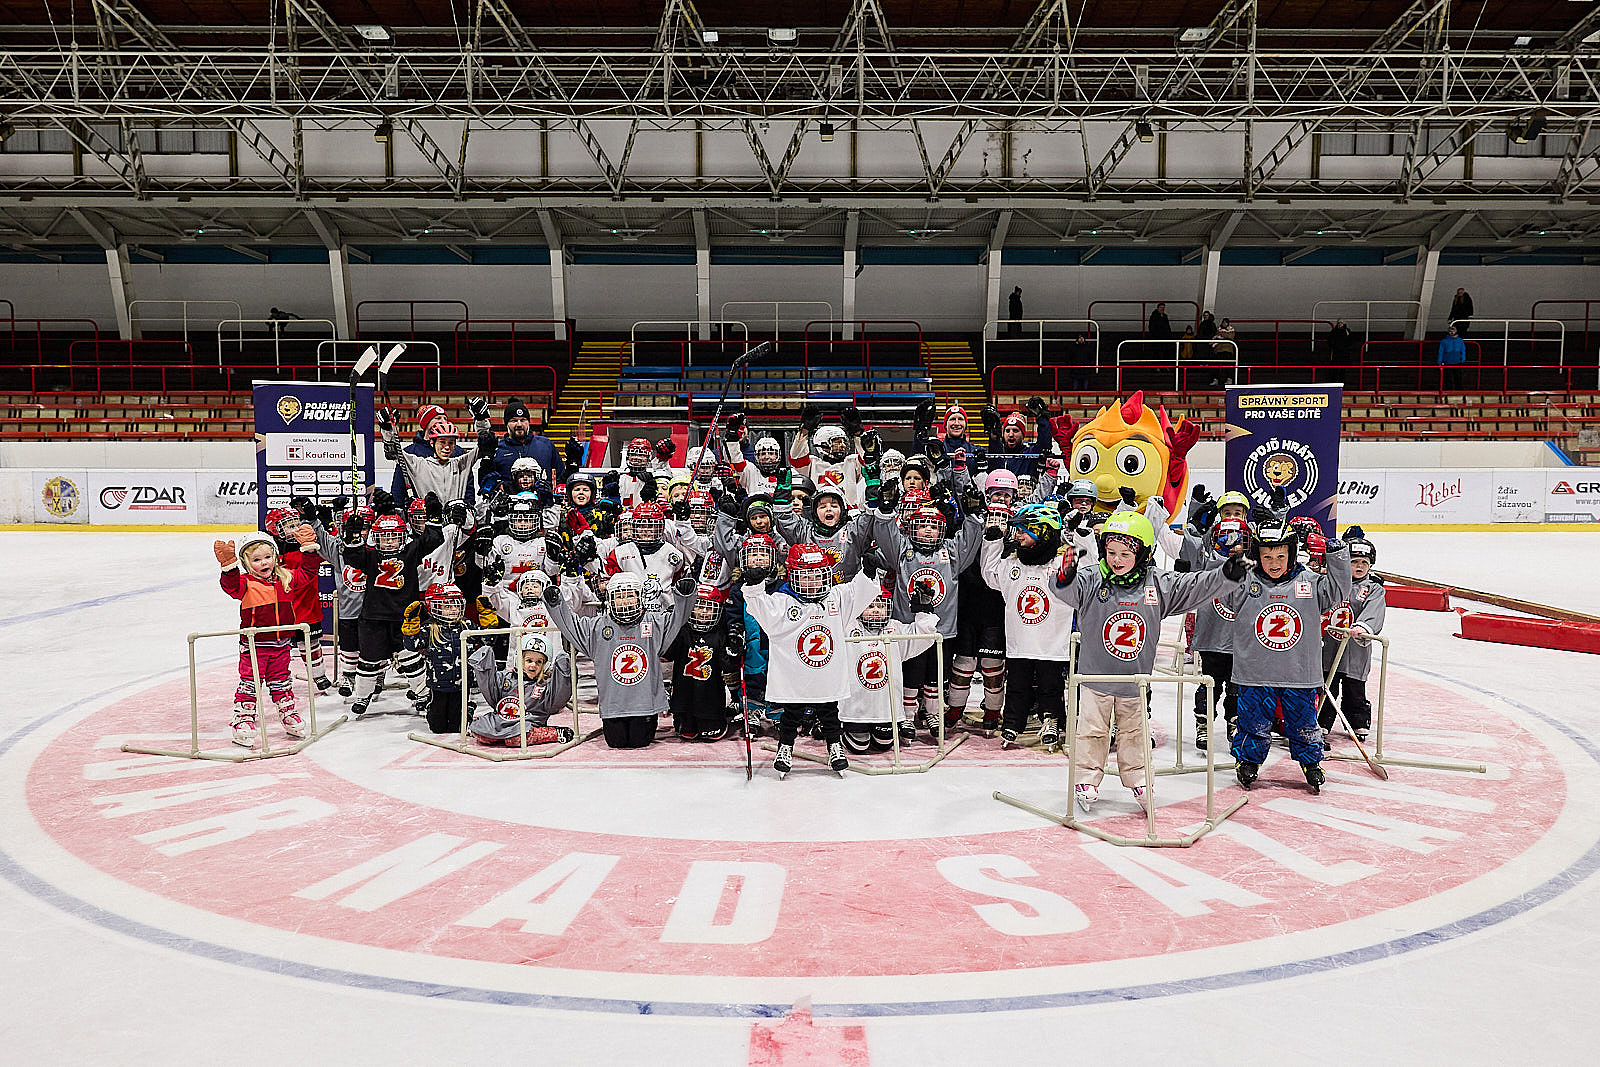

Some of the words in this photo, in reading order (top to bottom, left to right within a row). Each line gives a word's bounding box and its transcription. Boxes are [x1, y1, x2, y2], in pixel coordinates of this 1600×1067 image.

[305, 402, 328, 410] POJĎ
[1241, 396, 1288, 406] SPRÁVNÝ
[1291, 397, 1325, 405] SPORT
[303, 409, 351, 420] HOKEJ
[1245, 410, 1265, 419] PRO
[1268, 408, 1295, 419] VAŠE
[1297, 407, 1321, 419] DÍTĚ
[305, 451, 346, 459] Kaufland
[1249, 437, 1279, 463] POJĎ
[1282, 439, 1315, 462] HRÁT
[217, 481, 258, 496] HELP
[1337, 480, 1380, 500] LPing
[1415, 477, 1462, 507] Rebel
[1250, 487, 1309, 509] HOEJ
[1497, 500, 1532, 508] Sázavou
[292, 831, 786, 945] NAD
